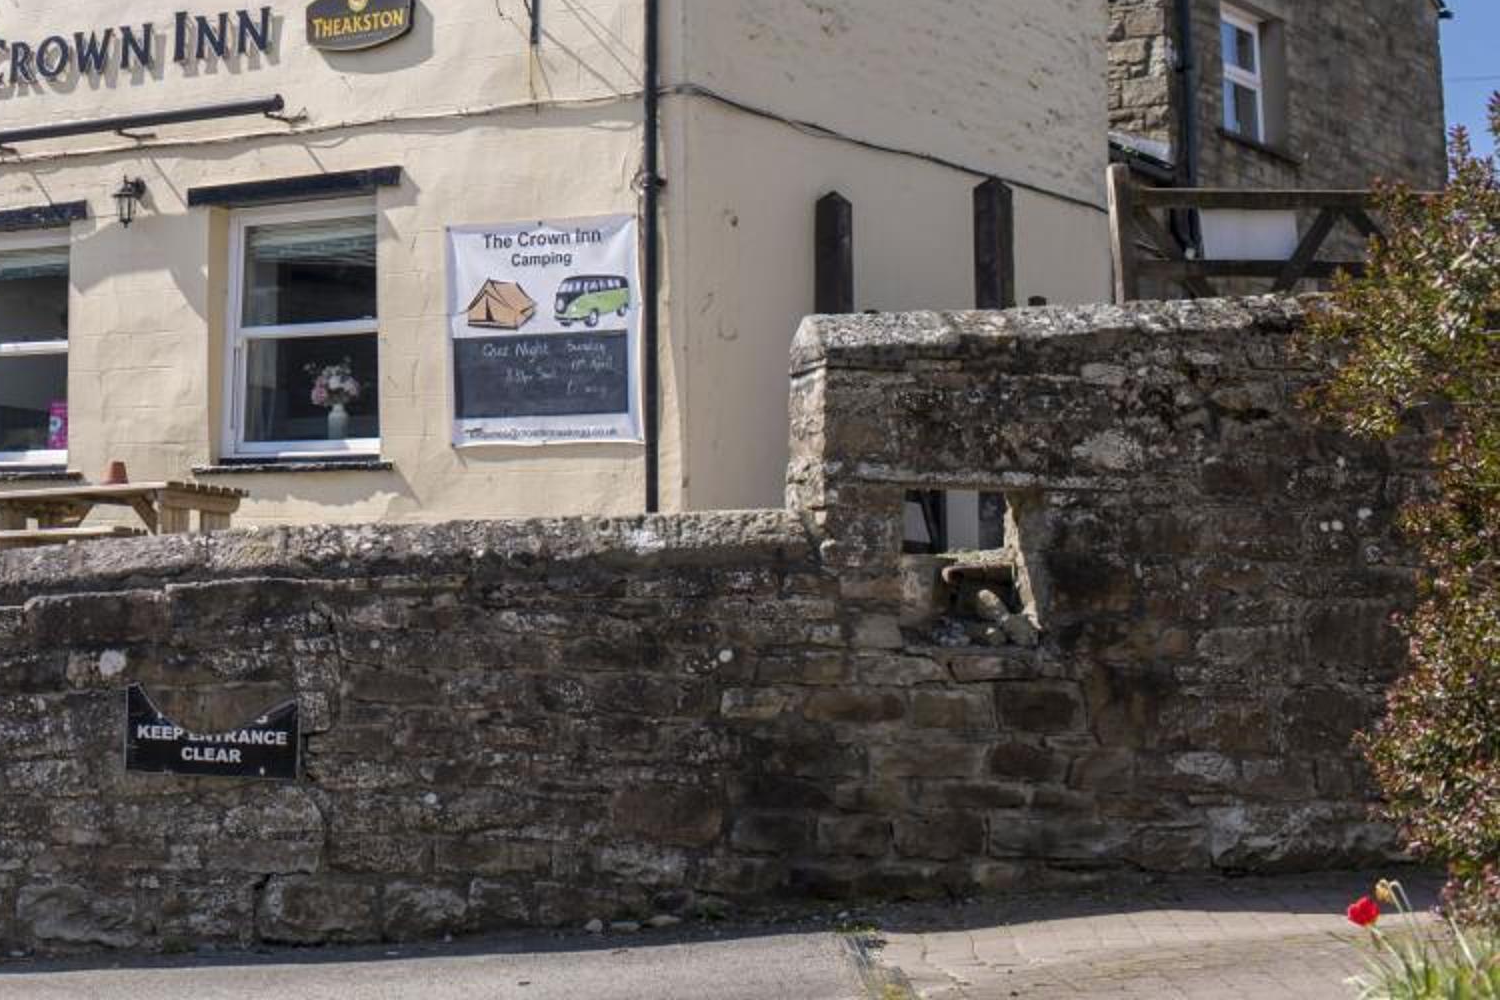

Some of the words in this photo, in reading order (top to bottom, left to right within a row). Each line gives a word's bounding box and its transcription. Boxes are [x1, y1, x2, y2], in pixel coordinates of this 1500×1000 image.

[313, 8, 404, 38] THEAKSTON
[174, 6, 271, 62] INN
[484, 233, 512, 249] The
[517, 230, 571, 247] Crown
[575, 228, 601, 243] Inn
[511, 252, 572, 268] Camping
[137, 725, 183, 741] KEEP
[181, 746, 241, 763] CLEAR
